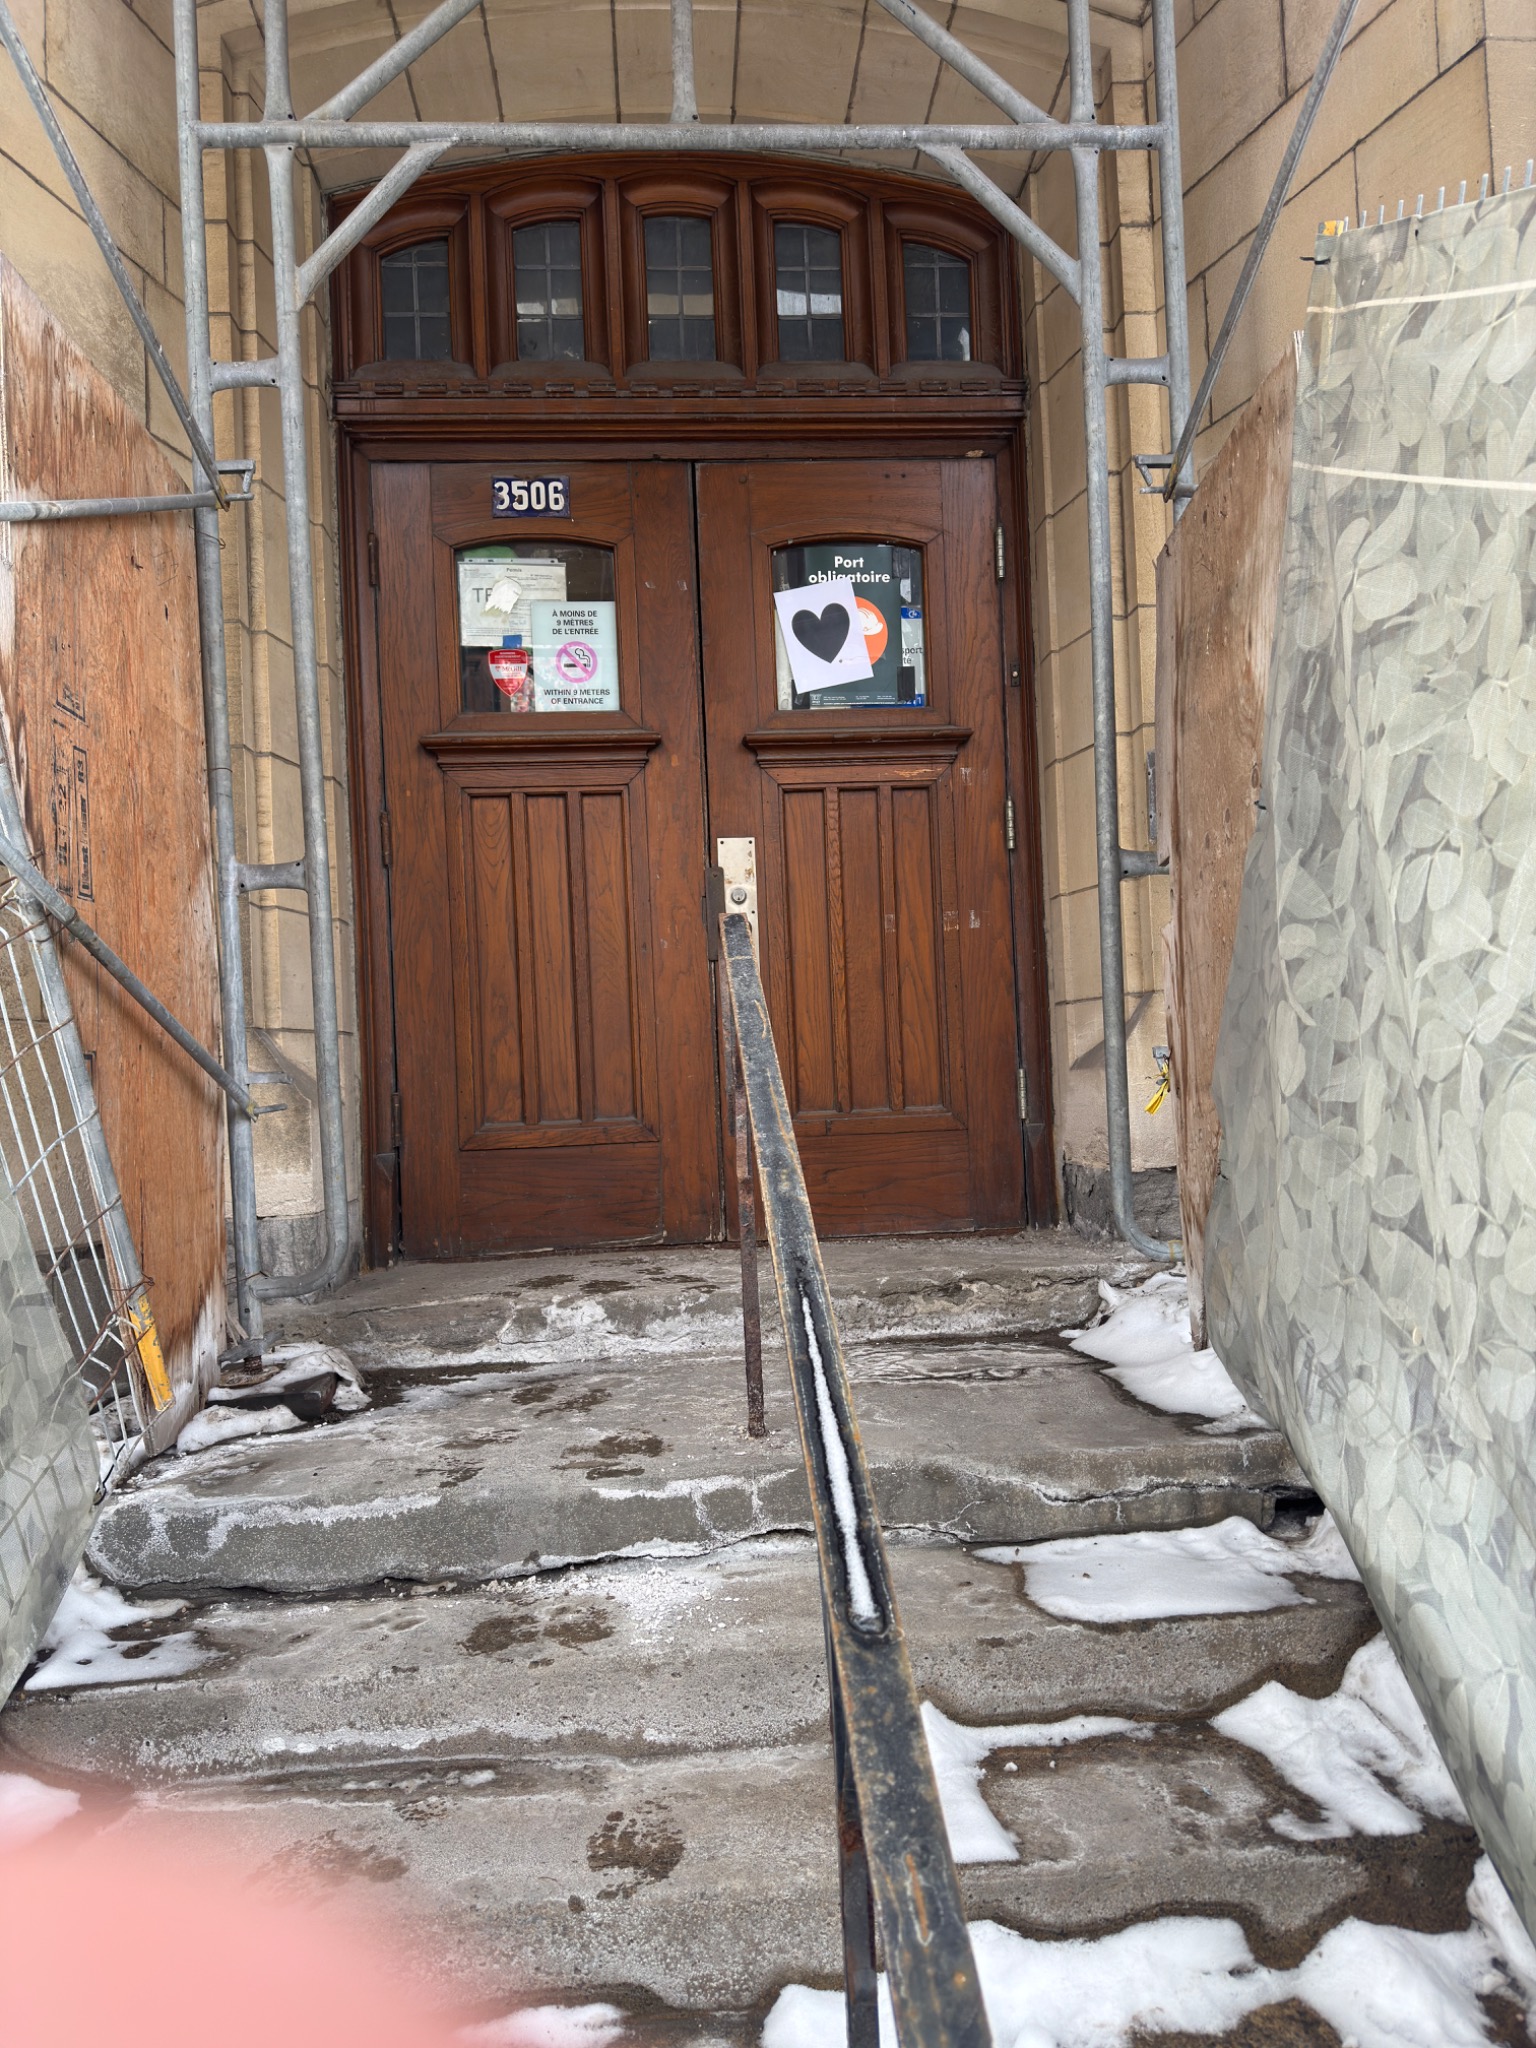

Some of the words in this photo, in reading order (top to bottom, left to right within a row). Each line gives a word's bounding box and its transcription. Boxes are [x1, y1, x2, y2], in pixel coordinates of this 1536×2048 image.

[494, 481, 564, 511] 3506
[834, 556, 864, 568] Port
[552, 609, 558, 618] À
[559, 610, 586, 618] MOINS
[587, 610, 598, 618] DE
[563, 618, 594, 626] MÈTRES
[564, 627, 599, 635] L'ENTRÉE
[550, 697, 562, 705] OF
[563, 697, 604, 705] ENTRANCE
